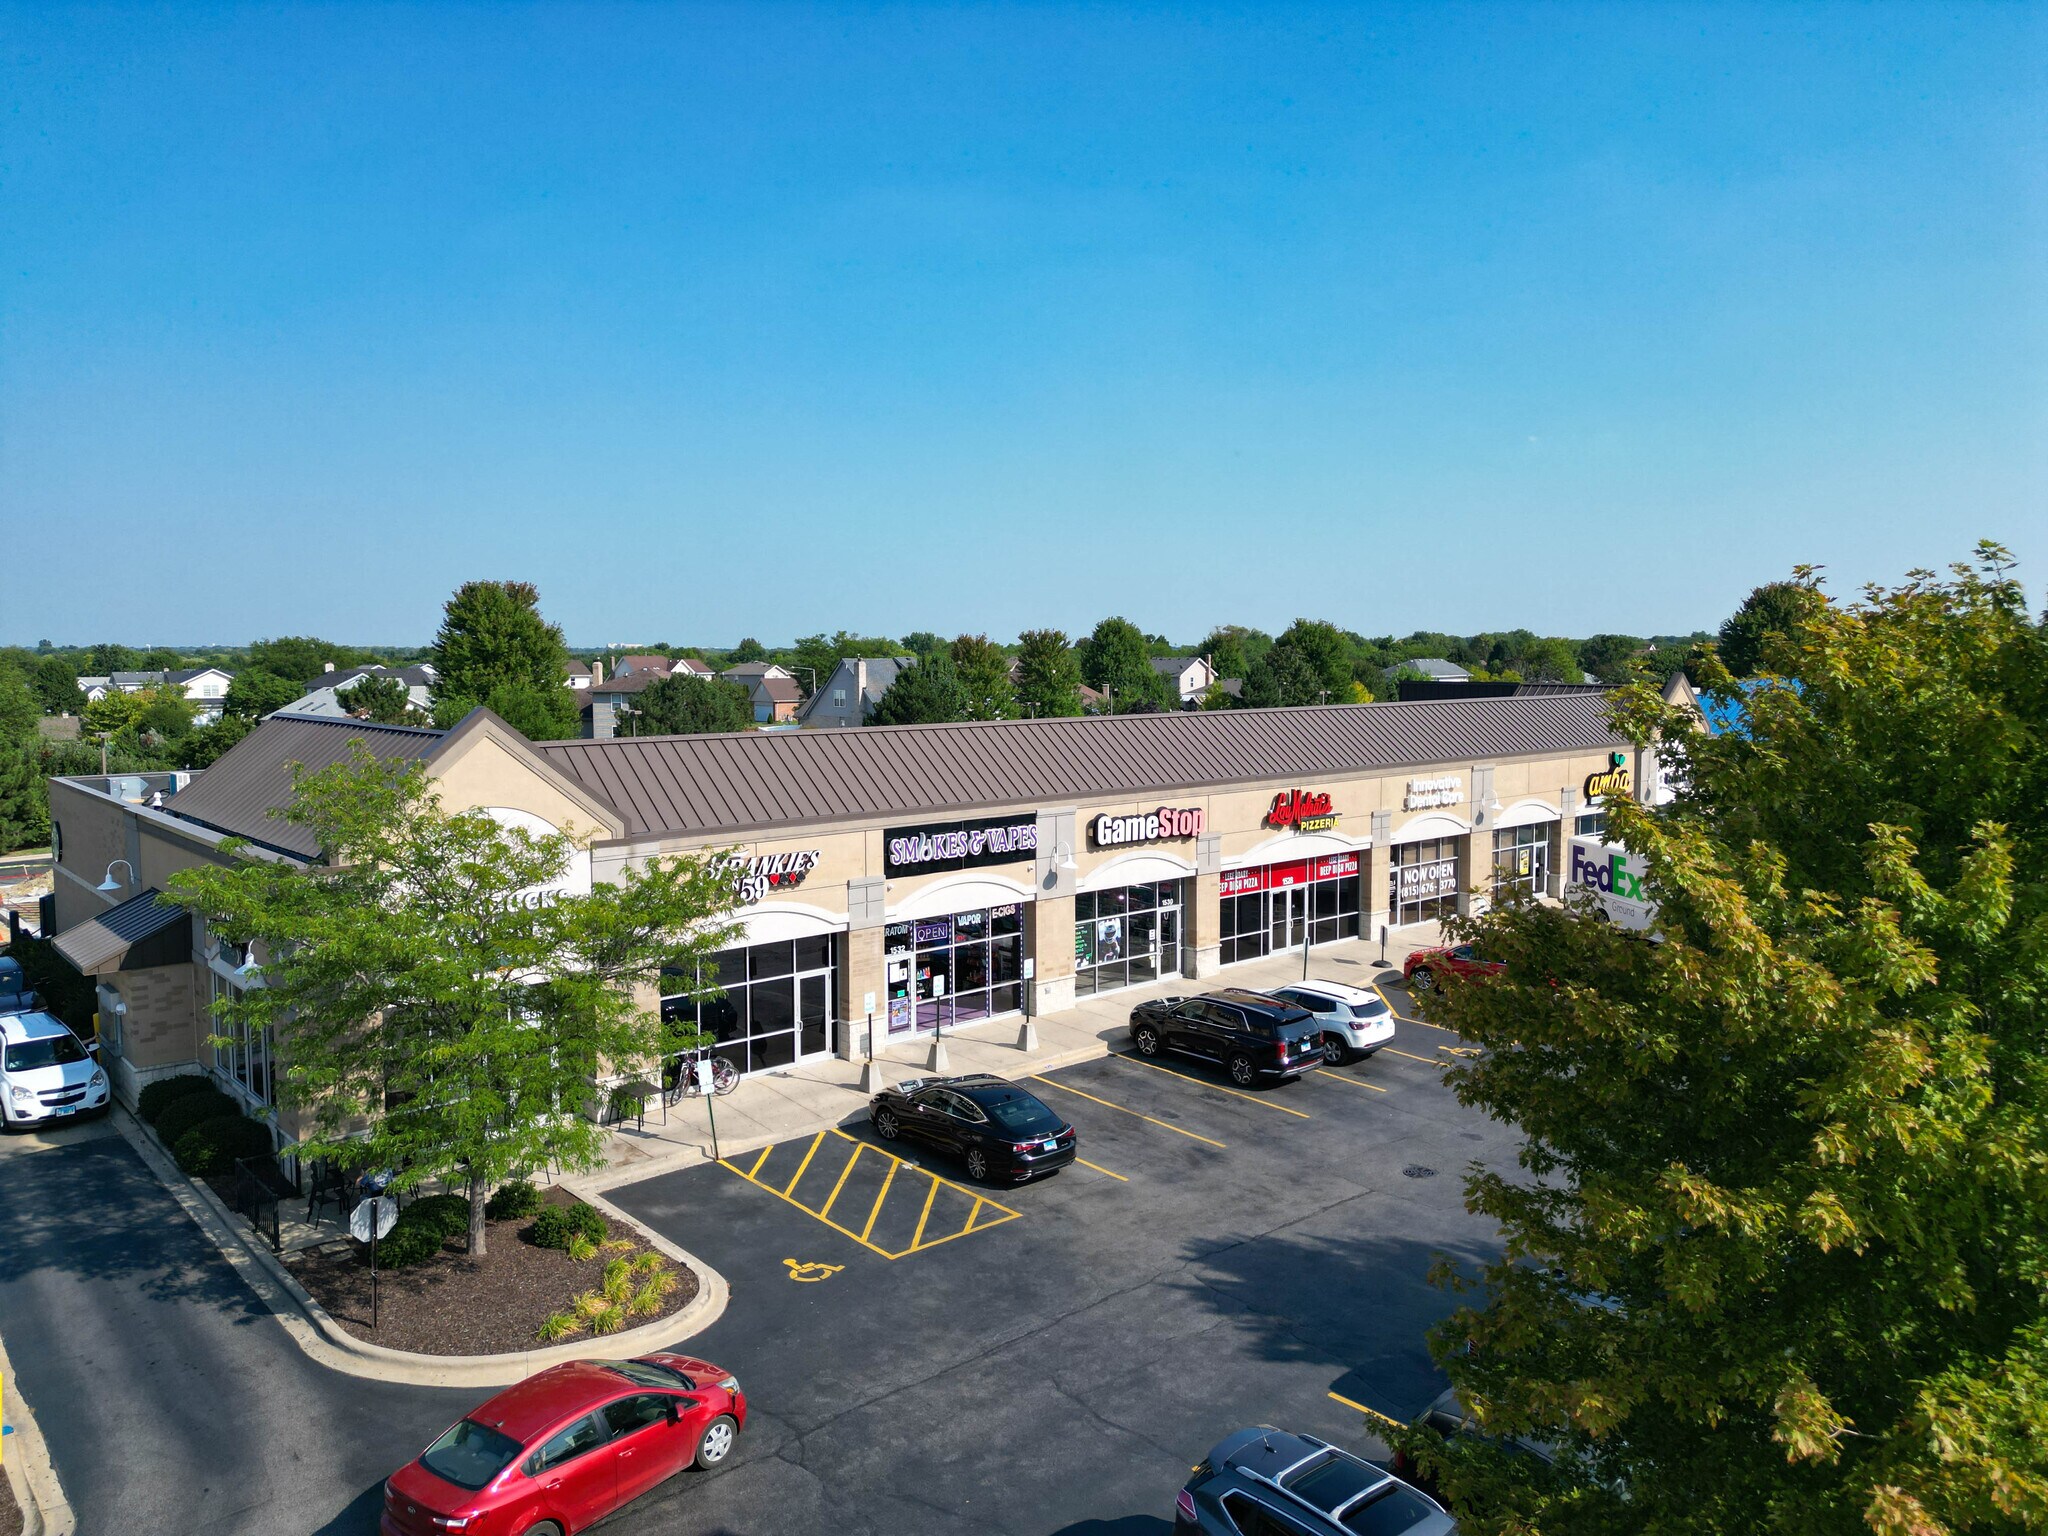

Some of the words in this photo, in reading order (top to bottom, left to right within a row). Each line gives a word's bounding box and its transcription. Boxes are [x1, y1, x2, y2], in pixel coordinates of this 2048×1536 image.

[1097, 808, 1206, 847] GameStop
[1301, 817, 1340, 832] PIZZERIA
[890, 831, 969, 866] SMOKES
[969, 830, 987, 855] &
[985, 825, 1039, 853] VAPES
[1320, 866, 1332, 878] DEEP
[1344, 860, 1358, 874] PIZZA
[1404, 867, 1427, 886] NOW
[1571, 844, 1644, 903] FedEx
[739, 874, 770, 902] 59
[1219, 881, 1229, 894] EEP
[1243, 876, 1259, 890] PIZZA
[1401, 883, 1419, 899] (815)
[1611, 900, 1635, 918] Ground
[957, 914, 982, 927] VAPOR
[885, 925, 908, 937] RATOM
[917, 926, 945, 940] OPEN
[890, 945, 906, 954] 1532
